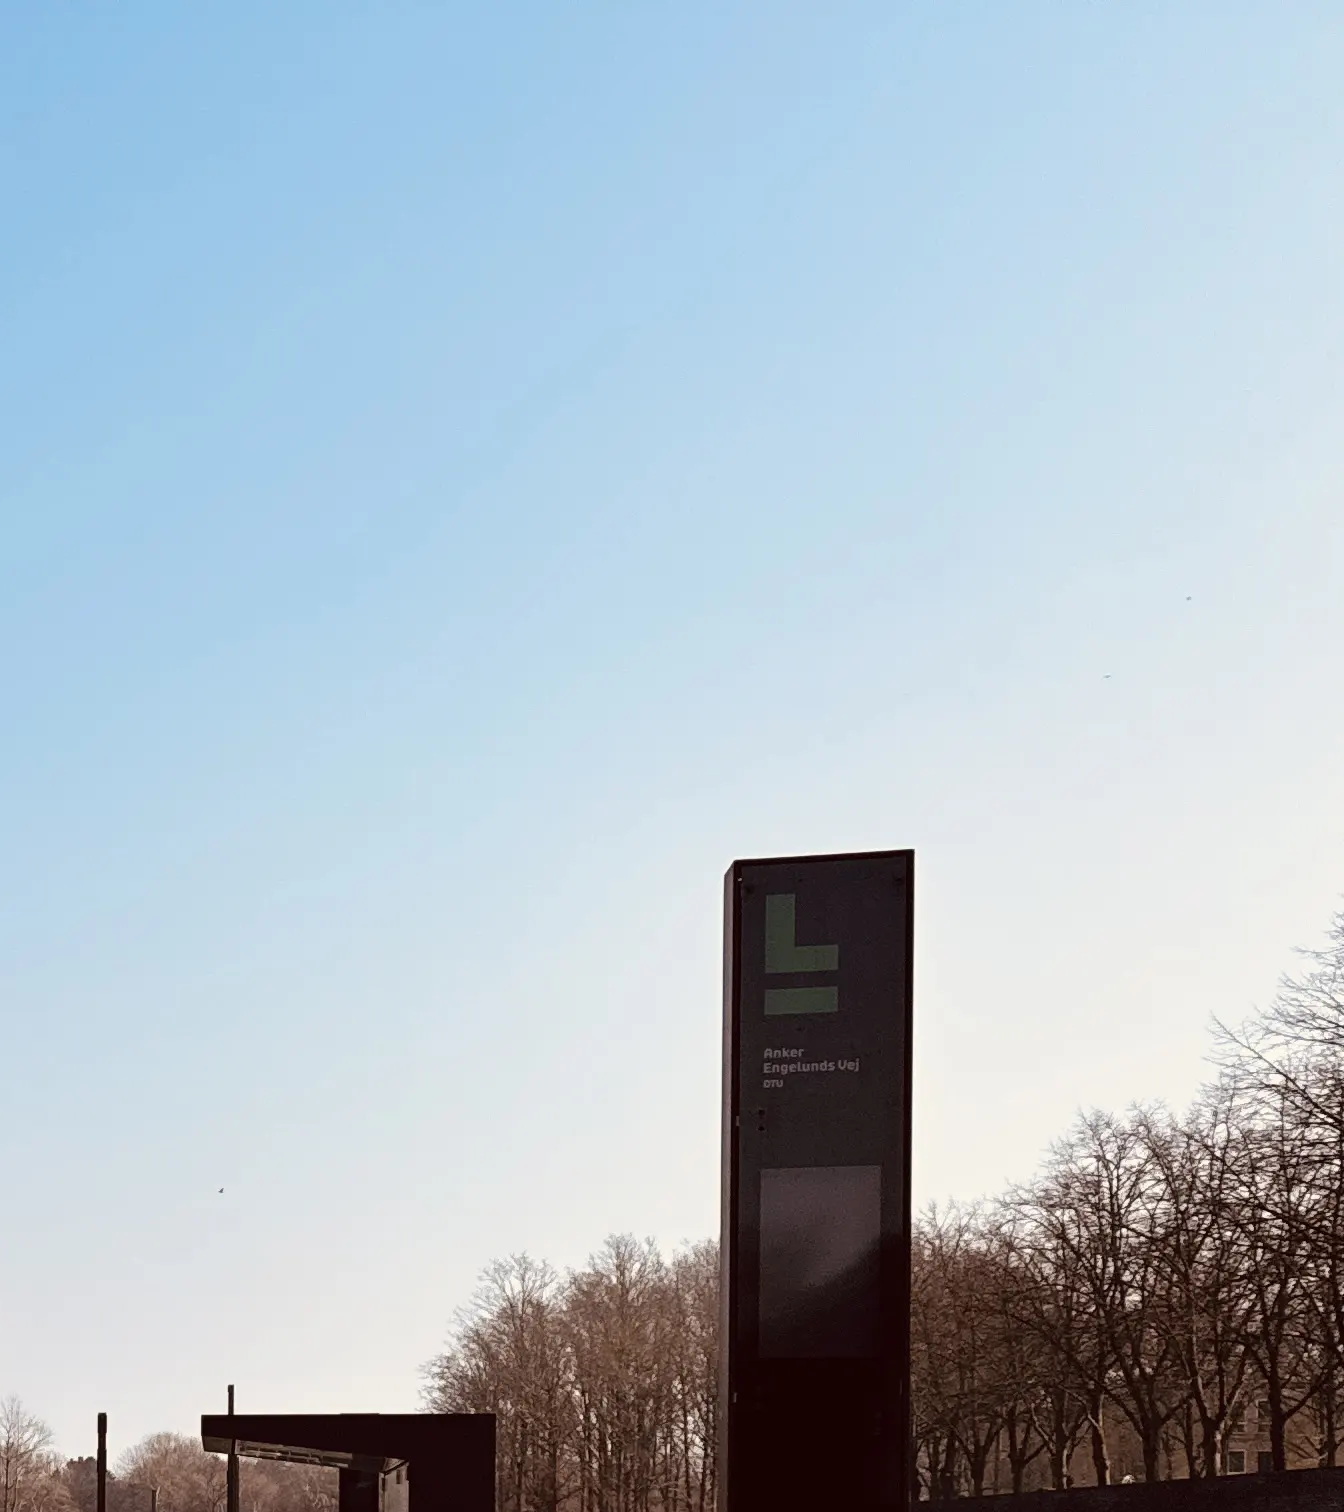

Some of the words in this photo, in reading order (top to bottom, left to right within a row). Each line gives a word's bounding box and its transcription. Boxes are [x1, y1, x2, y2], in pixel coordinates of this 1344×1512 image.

[763, 1048, 804, 1059] Anker
[763, 1061, 836, 1075] Engelunds
[838, 1058, 860, 1072] Vej
[763, 1079, 784, 1088] DTU
